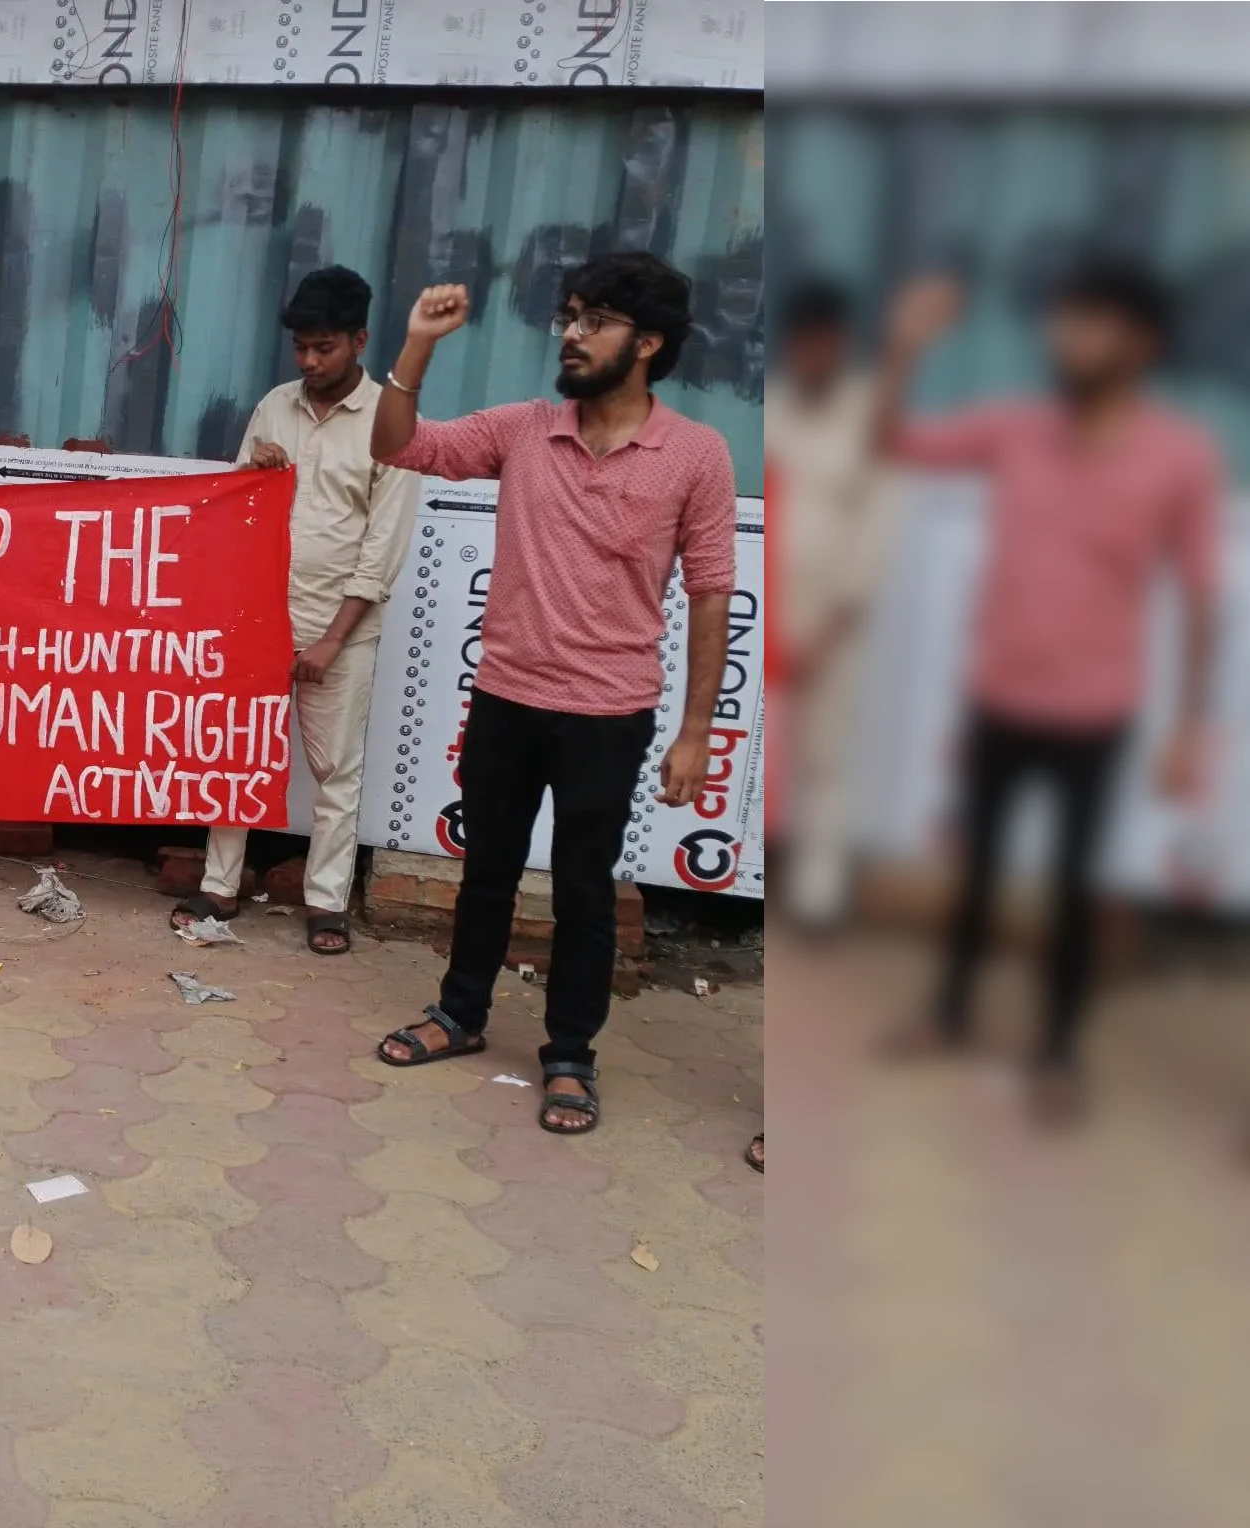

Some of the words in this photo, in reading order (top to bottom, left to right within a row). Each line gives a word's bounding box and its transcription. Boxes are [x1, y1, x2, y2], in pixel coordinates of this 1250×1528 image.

[55, 504, 191, 607] THE
[145, 690, 292, 772] RIGHTS
[44, 760, 272, 824] ACTIVISTS
